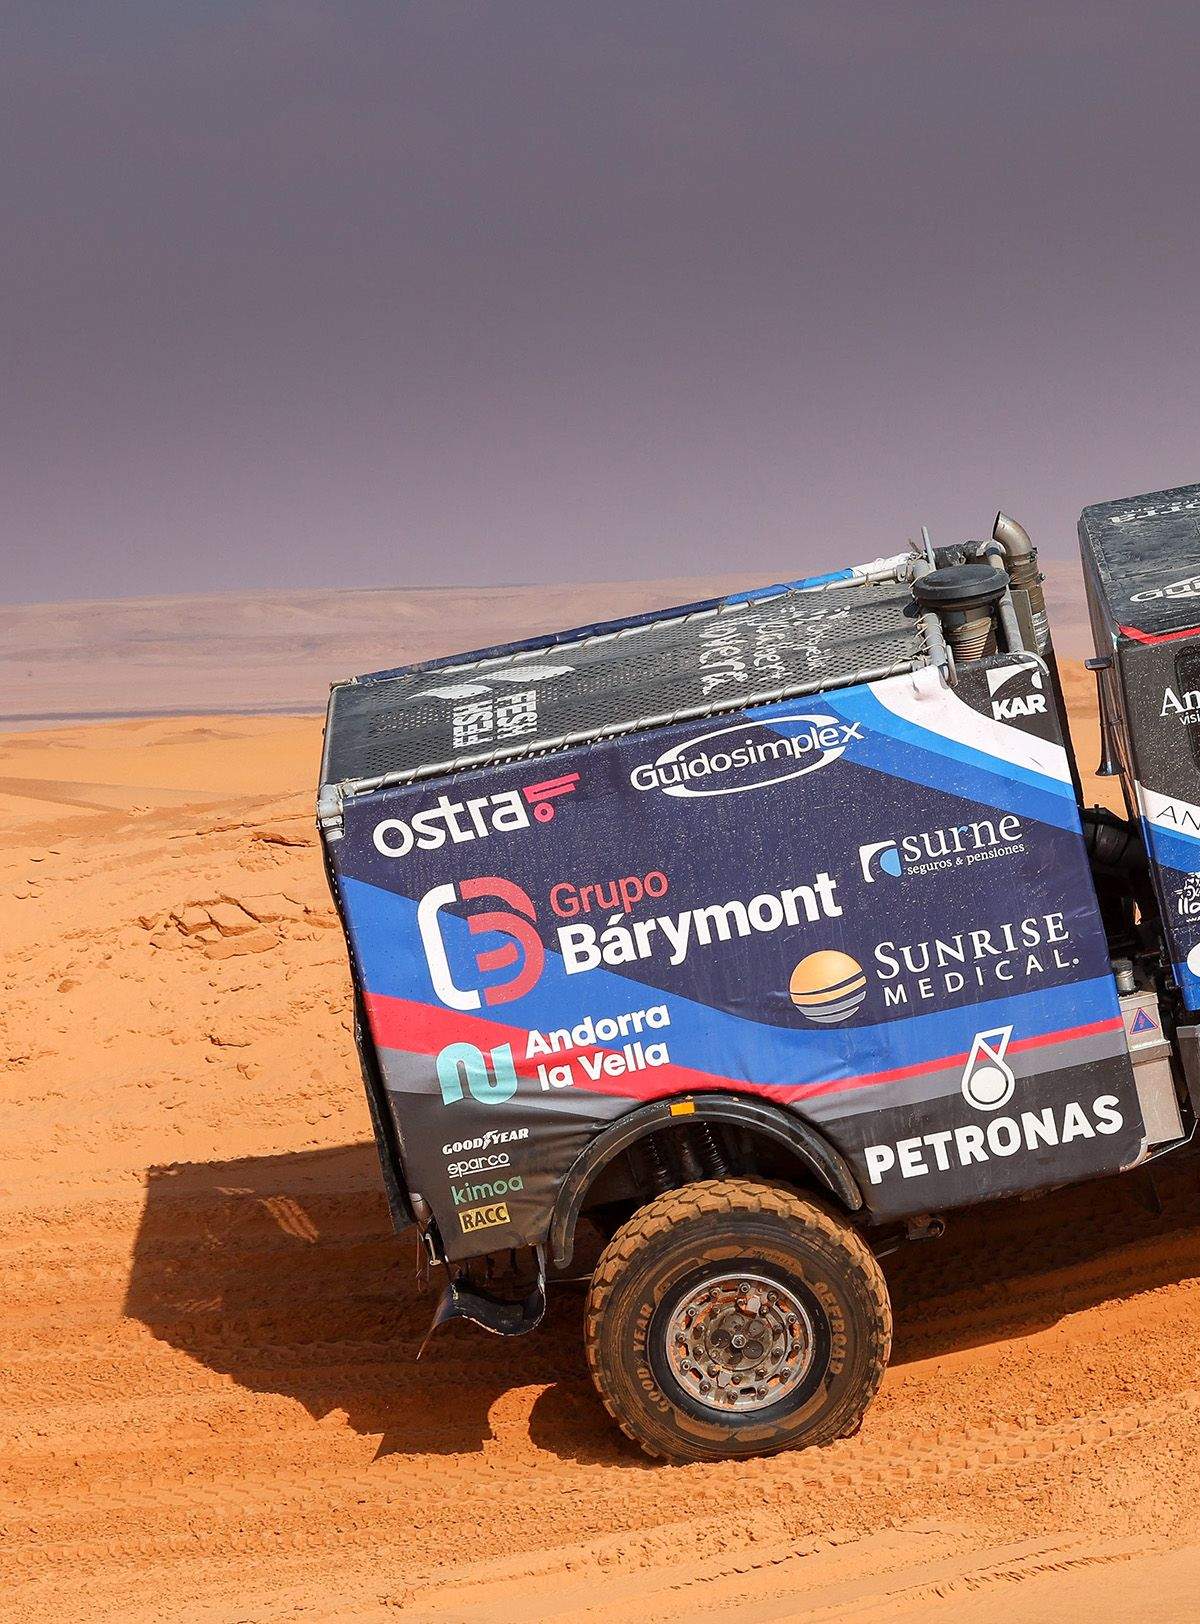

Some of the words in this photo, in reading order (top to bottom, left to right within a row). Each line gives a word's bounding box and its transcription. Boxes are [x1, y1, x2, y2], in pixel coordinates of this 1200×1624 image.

[452, 699, 494, 749] FESH
[991, 696, 1047, 721] KAR
[631, 720, 865, 792] Guidosimplex
[372, 789, 531, 858] ostra
[902, 815, 1023, 862] surne
[907, 859, 953, 876] seguros
[955, 857, 964, 868] &
[966, 843, 1025, 867] pensiones
[549, 870, 670, 918] Grupo
[556, 871, 844, 975] Bárymont
[873, 911, 1070, 981] SUNRISE
[525, 1003, 672, 1060] Andorra
[537, 1062, 575, 1092] la
[578, 1039, 671, 1083] Vella
[442, 1127, 530, 1155] GOODYEAR
[863, 1094, 1125, 1185] PETRONAS
[447, 1152, 511, 1178] sparco
[450, 1175, 524, 1206] kimoa
[461, 1205, 508, 1230] RACC
